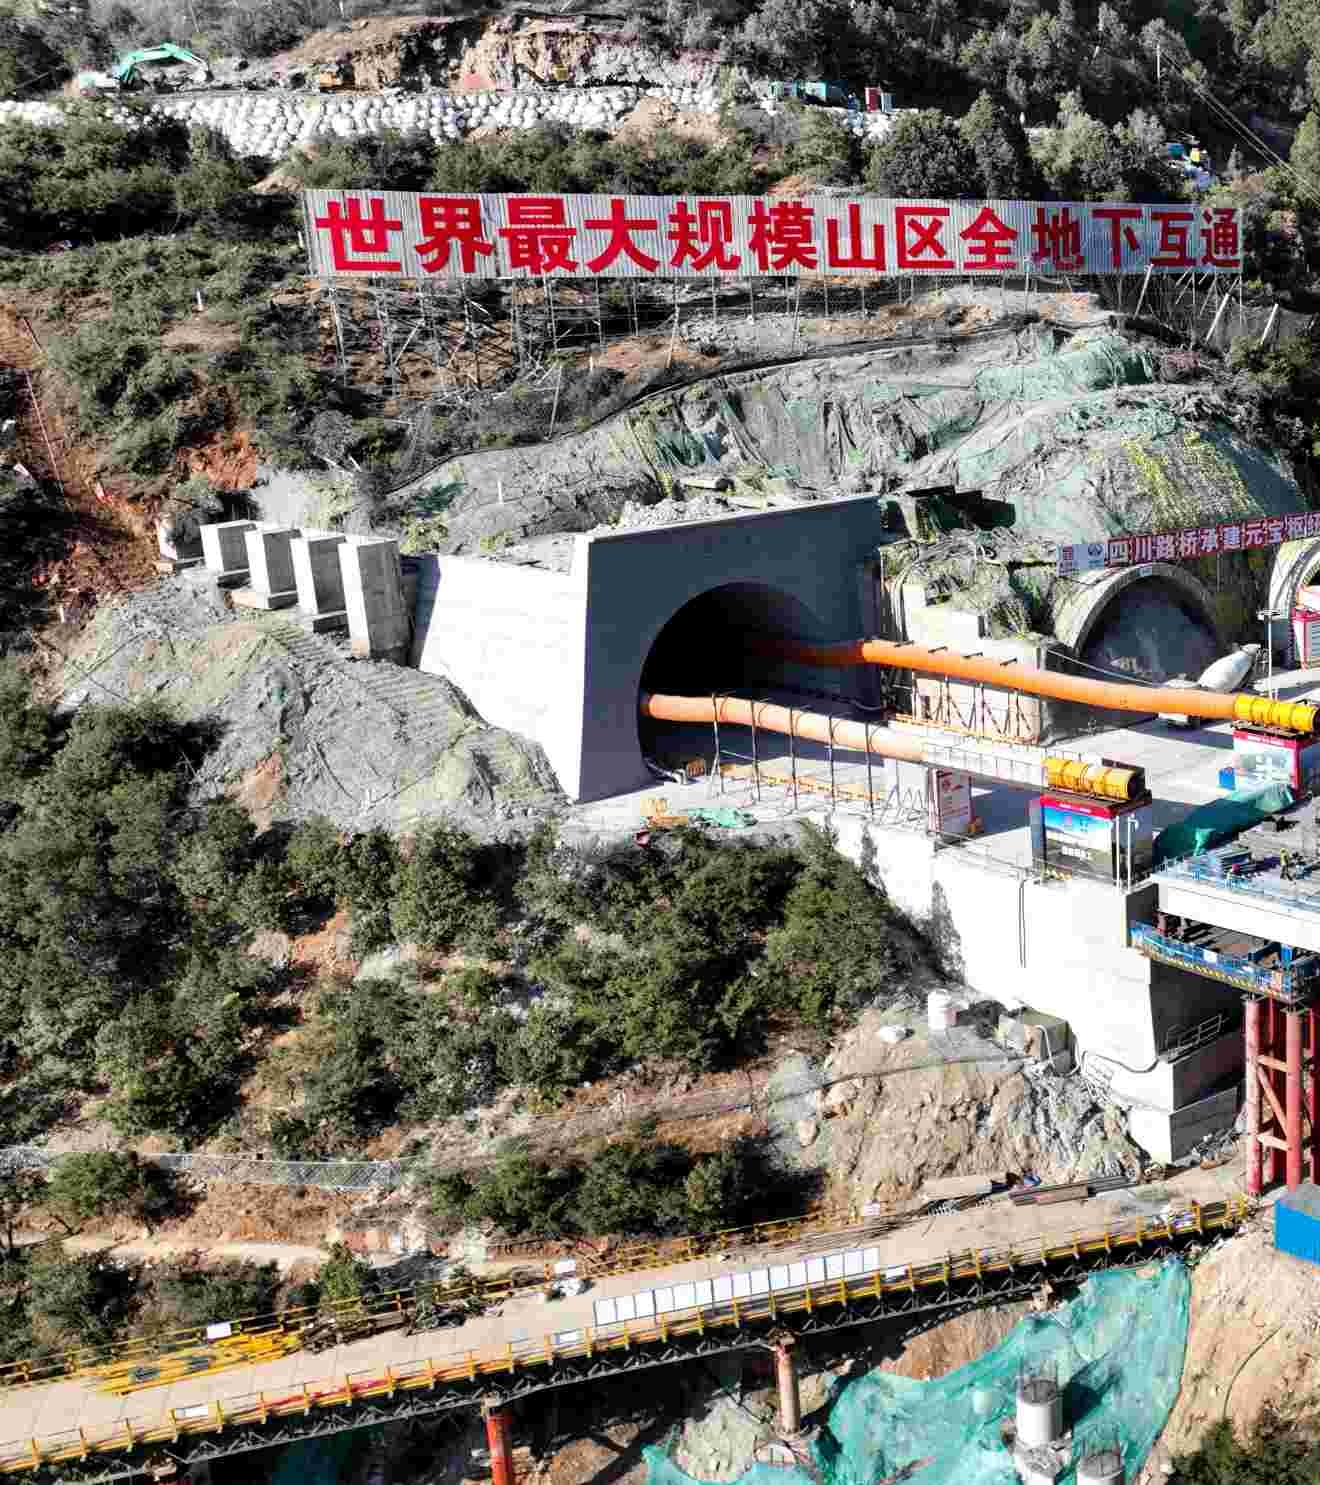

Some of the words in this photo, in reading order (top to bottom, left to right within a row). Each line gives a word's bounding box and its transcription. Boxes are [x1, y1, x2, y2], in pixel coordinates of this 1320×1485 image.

[315, 197, 1239, 273] 世界最大规模山区全地下互通
